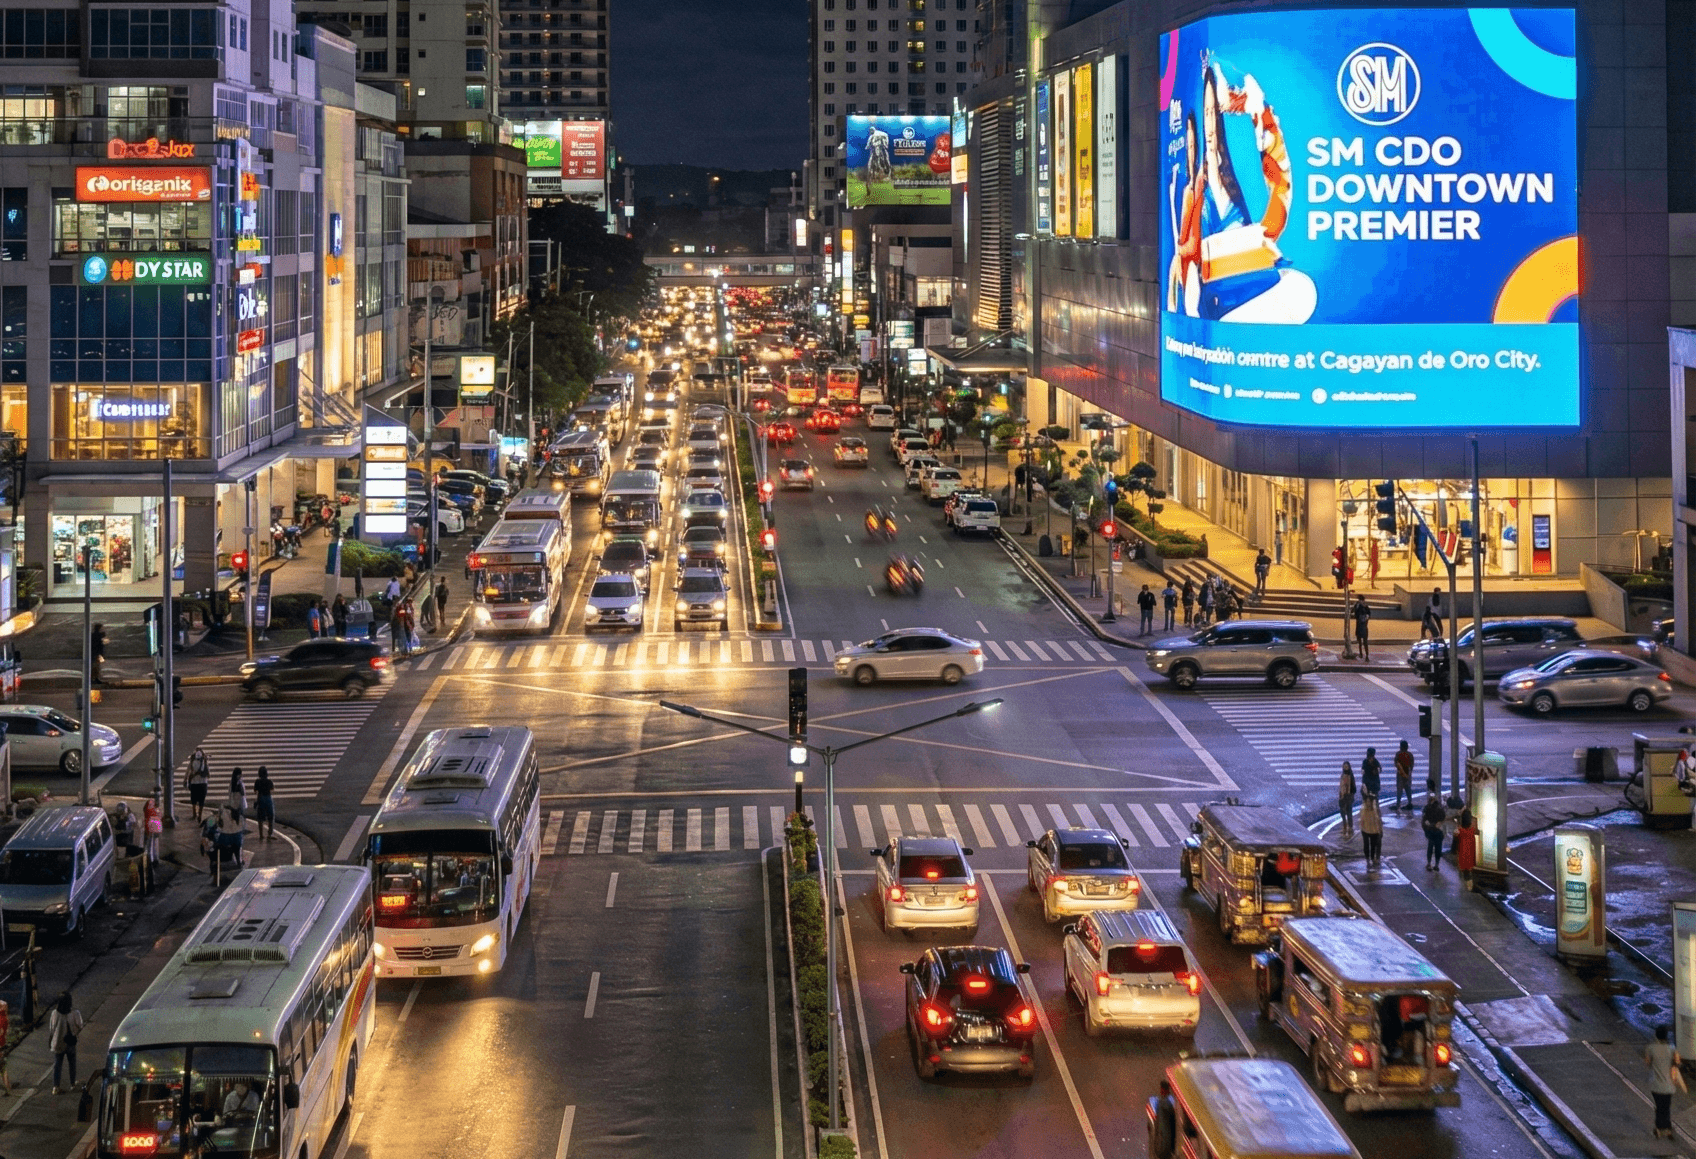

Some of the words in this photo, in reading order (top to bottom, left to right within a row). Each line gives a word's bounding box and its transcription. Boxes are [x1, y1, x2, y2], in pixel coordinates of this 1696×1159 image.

[1346, 54, 1407, 114] SM
[1307, 137, 1363, 166] SM
[1376, 137, 1461, 166] CDO
[1308, 173, 1553, 203] DOWNTOWN
[1308, 210, 1480, 240] PREMIER
[1294, 352, 1315, 369] at
[1320, 351, 1413, 373] Cagayan
[1418, 350, 1445, 369] de
[1450, 350, 1490, 369] Oro
[1495, 350, 1541, 373] City.
